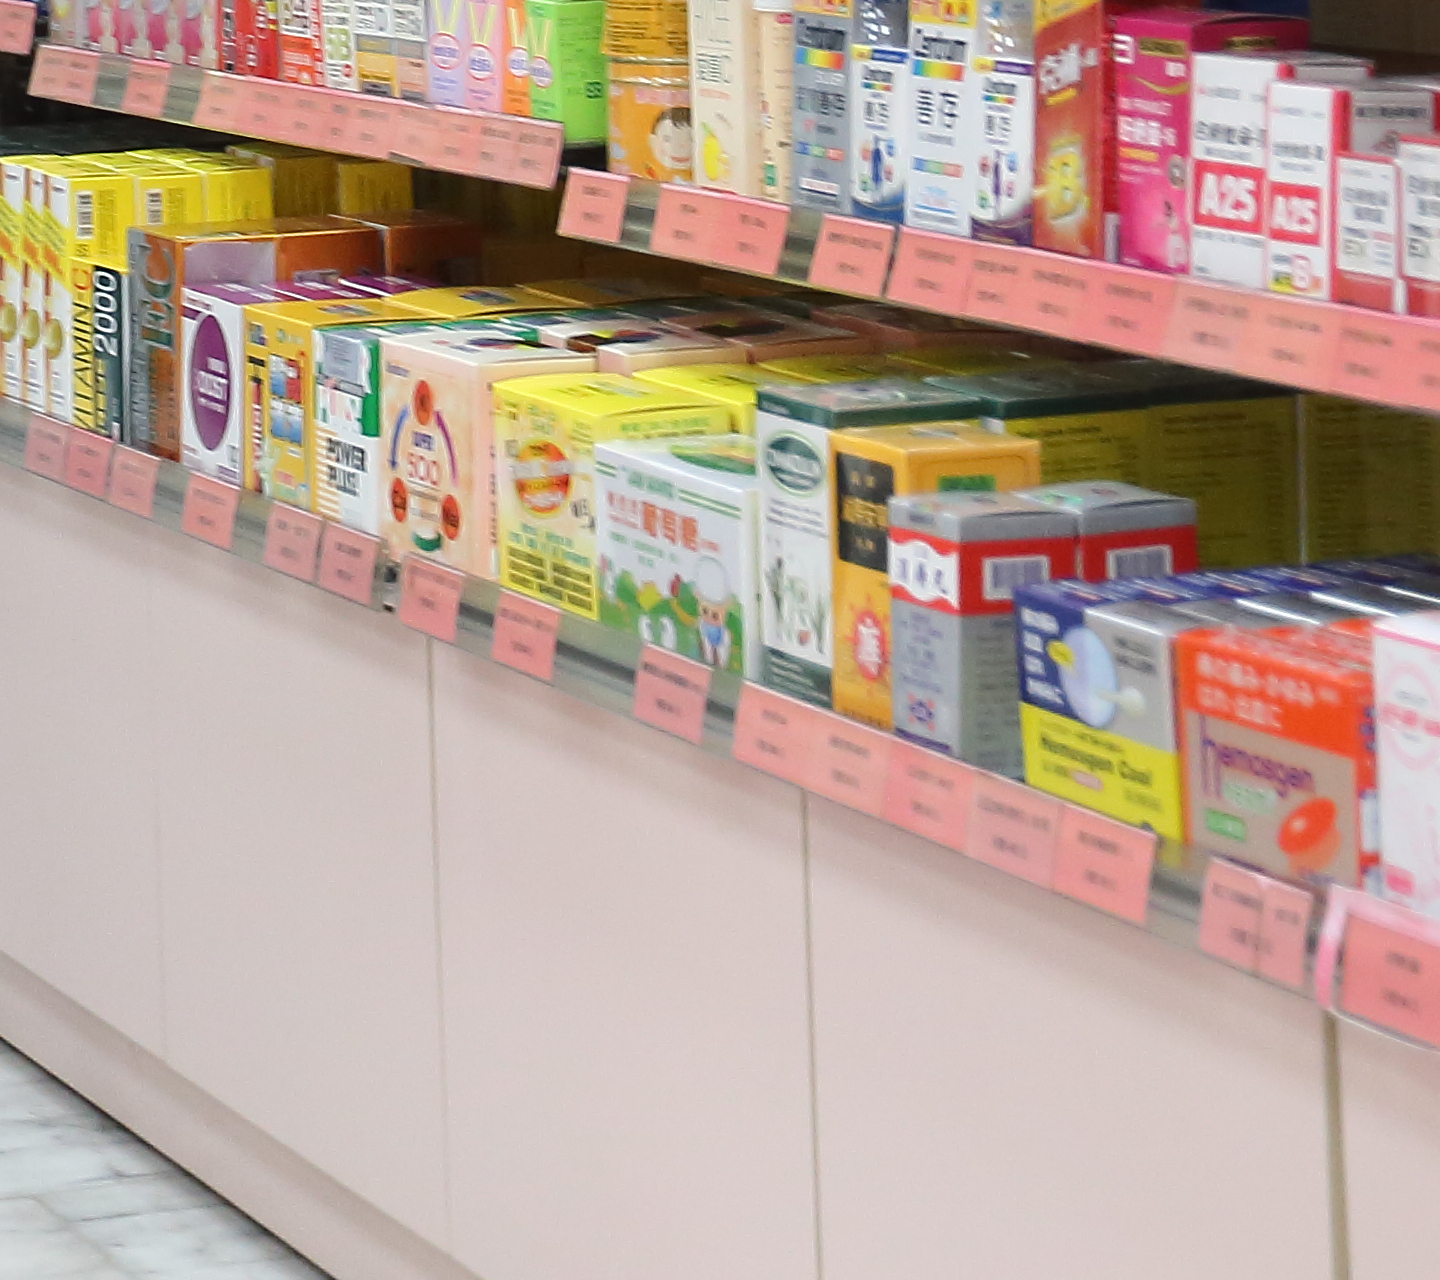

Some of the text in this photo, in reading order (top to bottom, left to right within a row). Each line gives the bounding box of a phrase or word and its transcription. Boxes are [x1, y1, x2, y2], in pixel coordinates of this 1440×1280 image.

[1200, 172, 1258, 223] A25
[1271, 194, 1319, 234] A25
[92, 269, 118, 357] 2000
